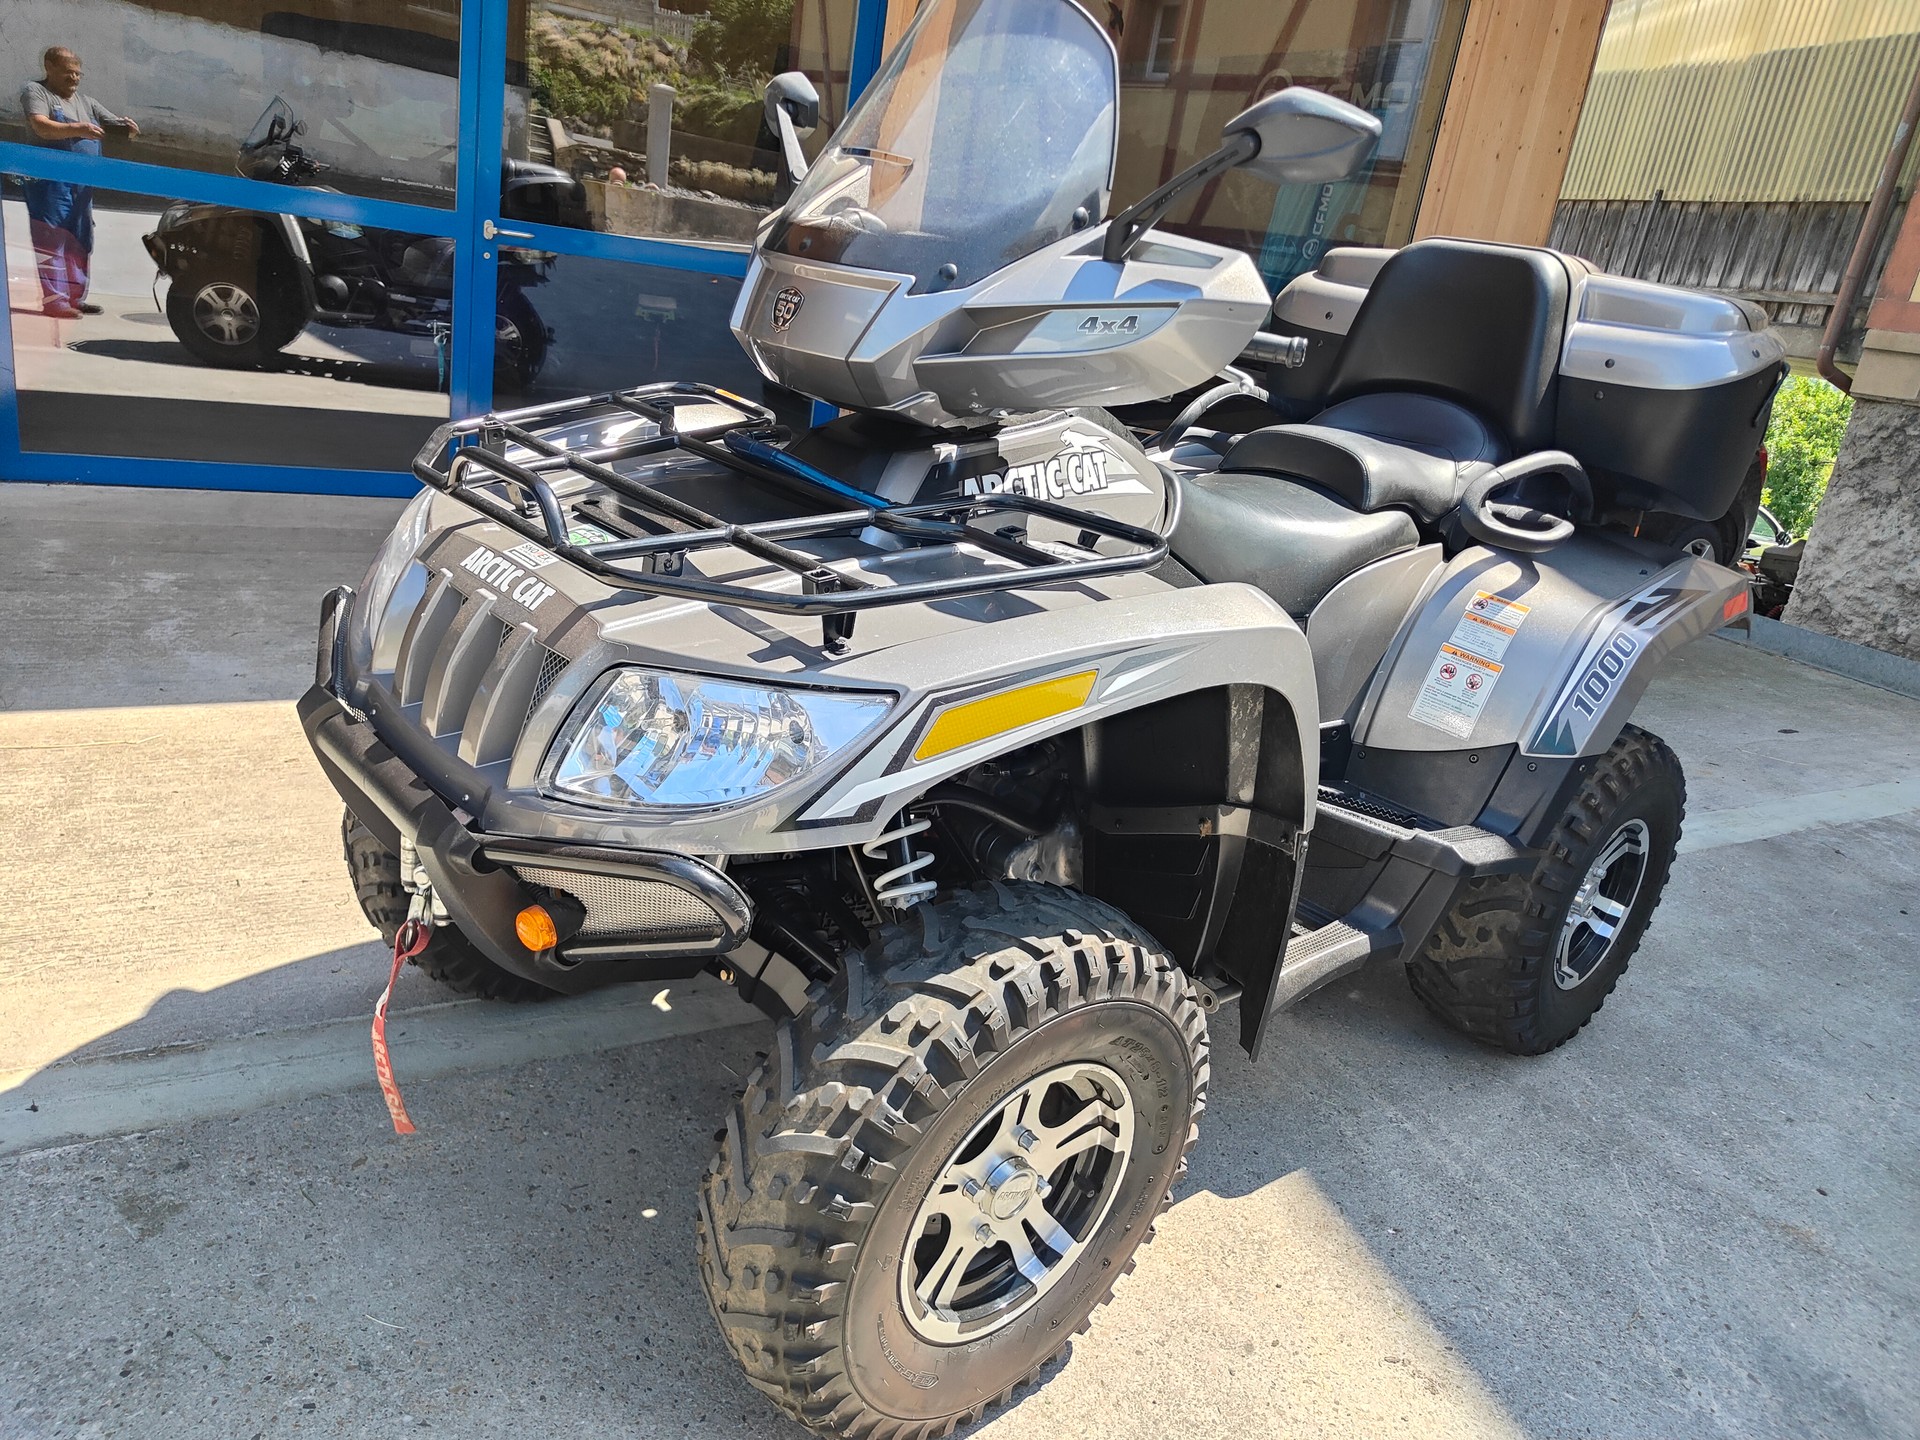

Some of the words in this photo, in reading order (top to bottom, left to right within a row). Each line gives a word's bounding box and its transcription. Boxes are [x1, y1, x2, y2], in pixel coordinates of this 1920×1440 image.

[775, 300, 795, 319] 50
[1077, 315, 1139, 335] 4x4
[1067, 451, 1109, 495] CAT
[460, 546, 526, 593] ARCTIC
[512, 576, 557, 611] CAT
[1480, 618, 1507, 632] WARNING
[1459, 651, 1491, 668] WARNING
[1572, 630, 1639, 721] 1000
